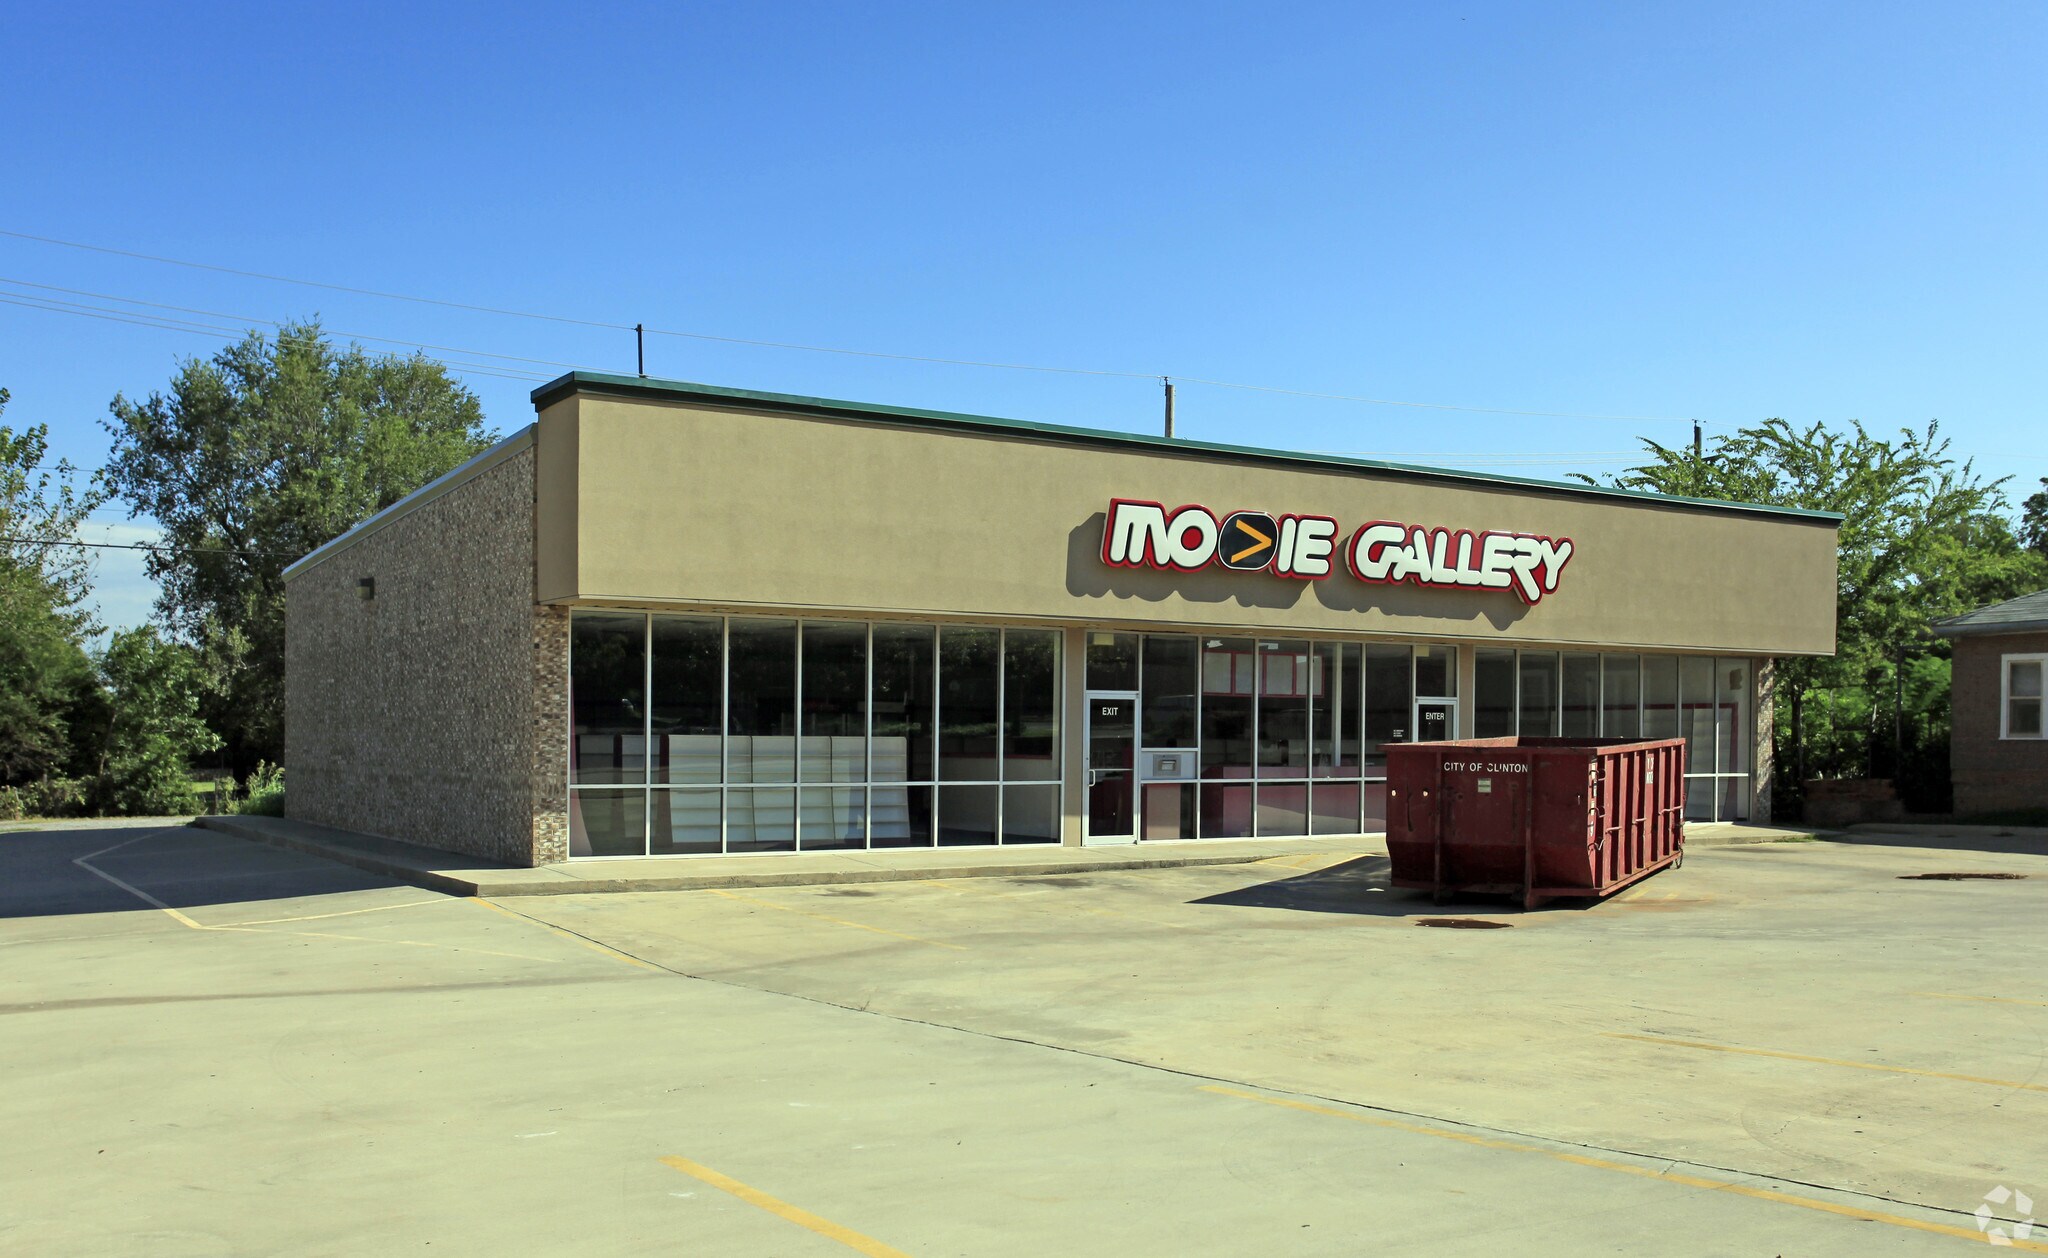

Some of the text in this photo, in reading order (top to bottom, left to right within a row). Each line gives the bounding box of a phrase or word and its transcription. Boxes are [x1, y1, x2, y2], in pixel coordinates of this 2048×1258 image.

[1352, 522, 1573, 603] GALLERY
[1102, 707, 1119, 716] EXIT
[1425, 712, 1445, 720] ENTER
[1443, 762, 1466, 772] CITY
[1469, 762, 1483, 772] OF
